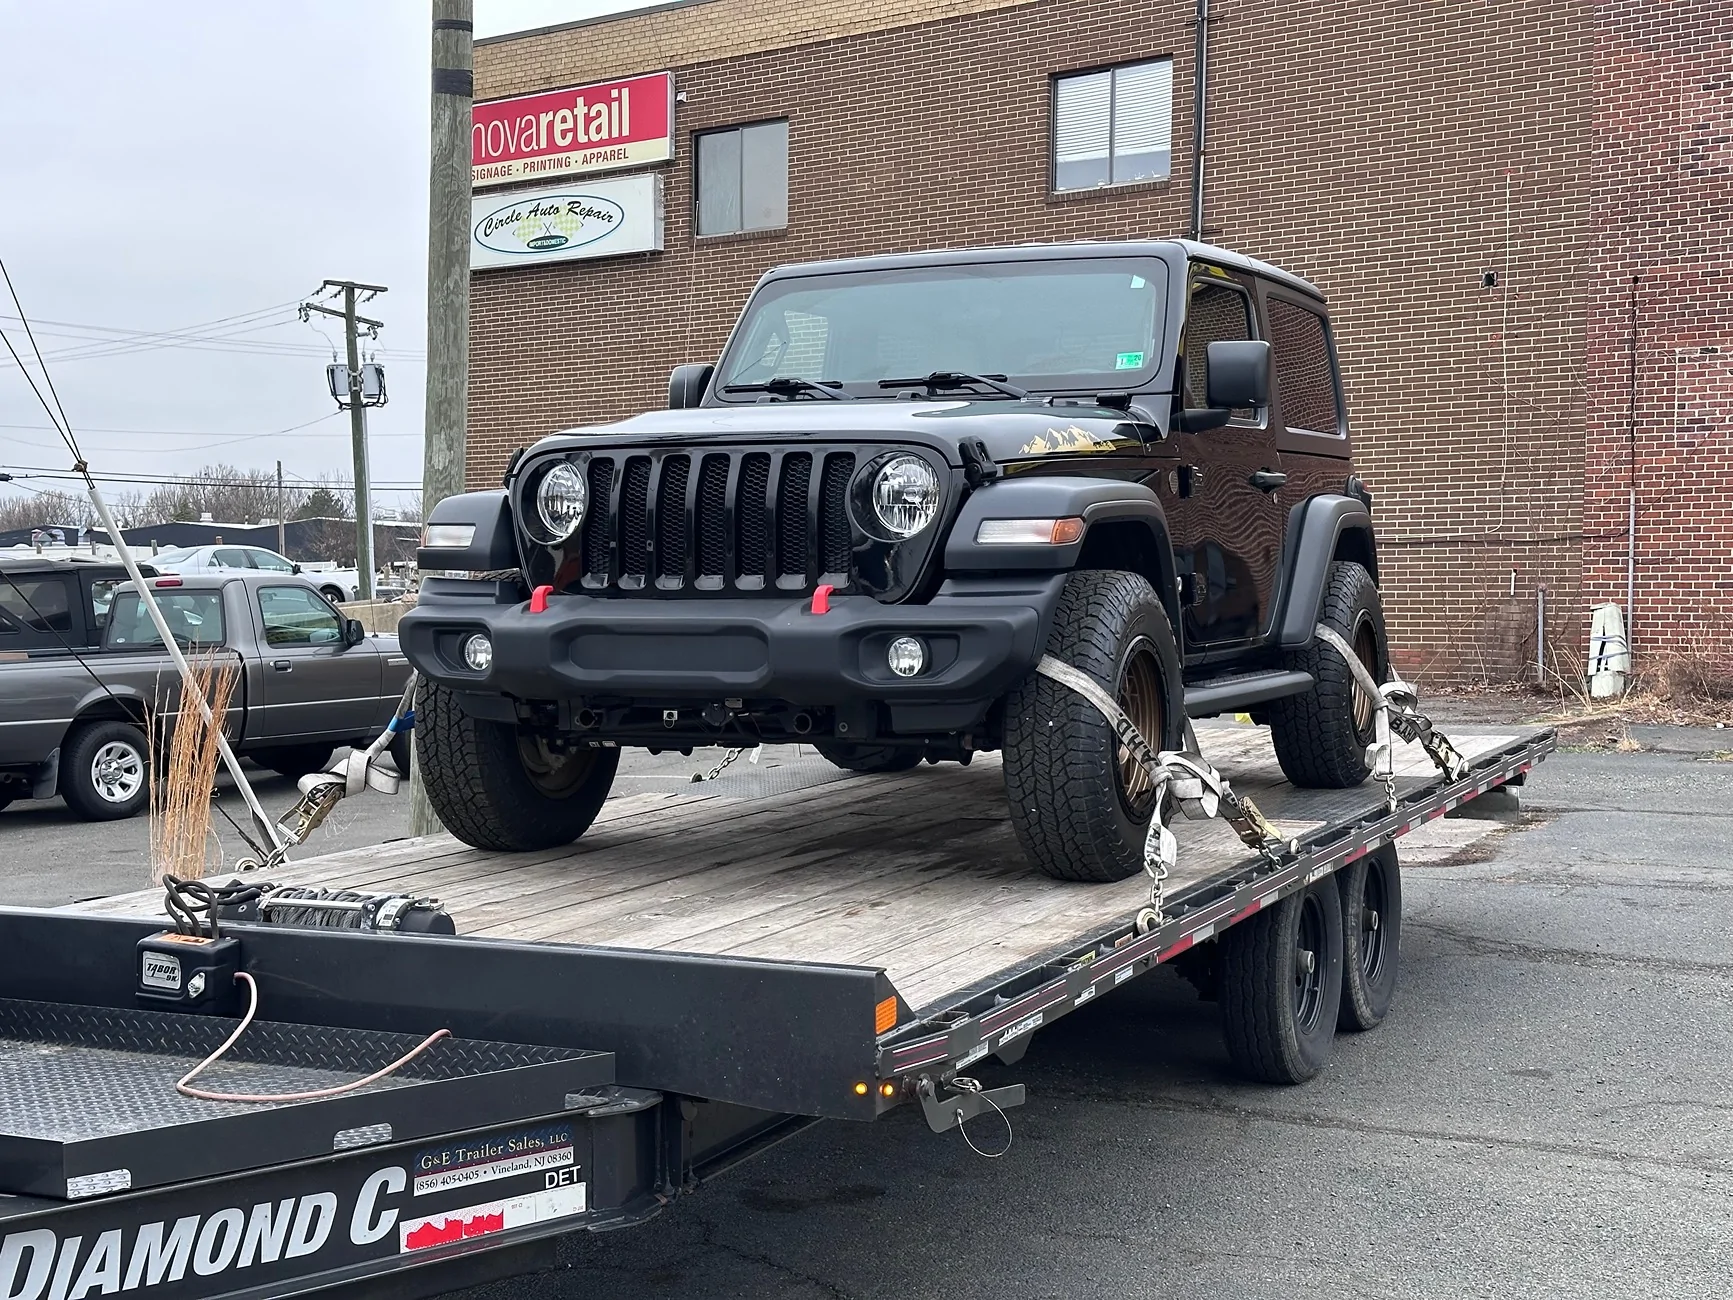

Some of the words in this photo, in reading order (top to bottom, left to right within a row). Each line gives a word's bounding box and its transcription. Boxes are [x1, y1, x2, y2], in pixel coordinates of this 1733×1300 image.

[471, 164, 513, 181] SIGNAGE
[523, 155, 571, 174] PRINTING
[581, 147, 629, 166] APPAREL
[483, 208, 522, 238] Circle
[525, 201, 561, 220] Auto
[566, 200, 614, 223] Repair
[146, 963, 177, 978] TABOR
[421, 1151, 451, 1170] G&E
[455, 1143, 504, 1163] Trailer
[508, 1136, 545, 1153] Sales,
[549, 1132, 568, 1145] LLC
[416, 1177, 438, 1192] (856)
[440, 1169, 480, 1186] 405-0405
[491, 1159, 532, 1175] Vineland,
[534, 1156, 545, 1167] NJ
[547, 1151, 572, 1164] 08360
[545, 1164, 581, 1190] DET
[0, 1191, 338, 1300] DIAMOND
[349, 1166, 407, 1246] C
